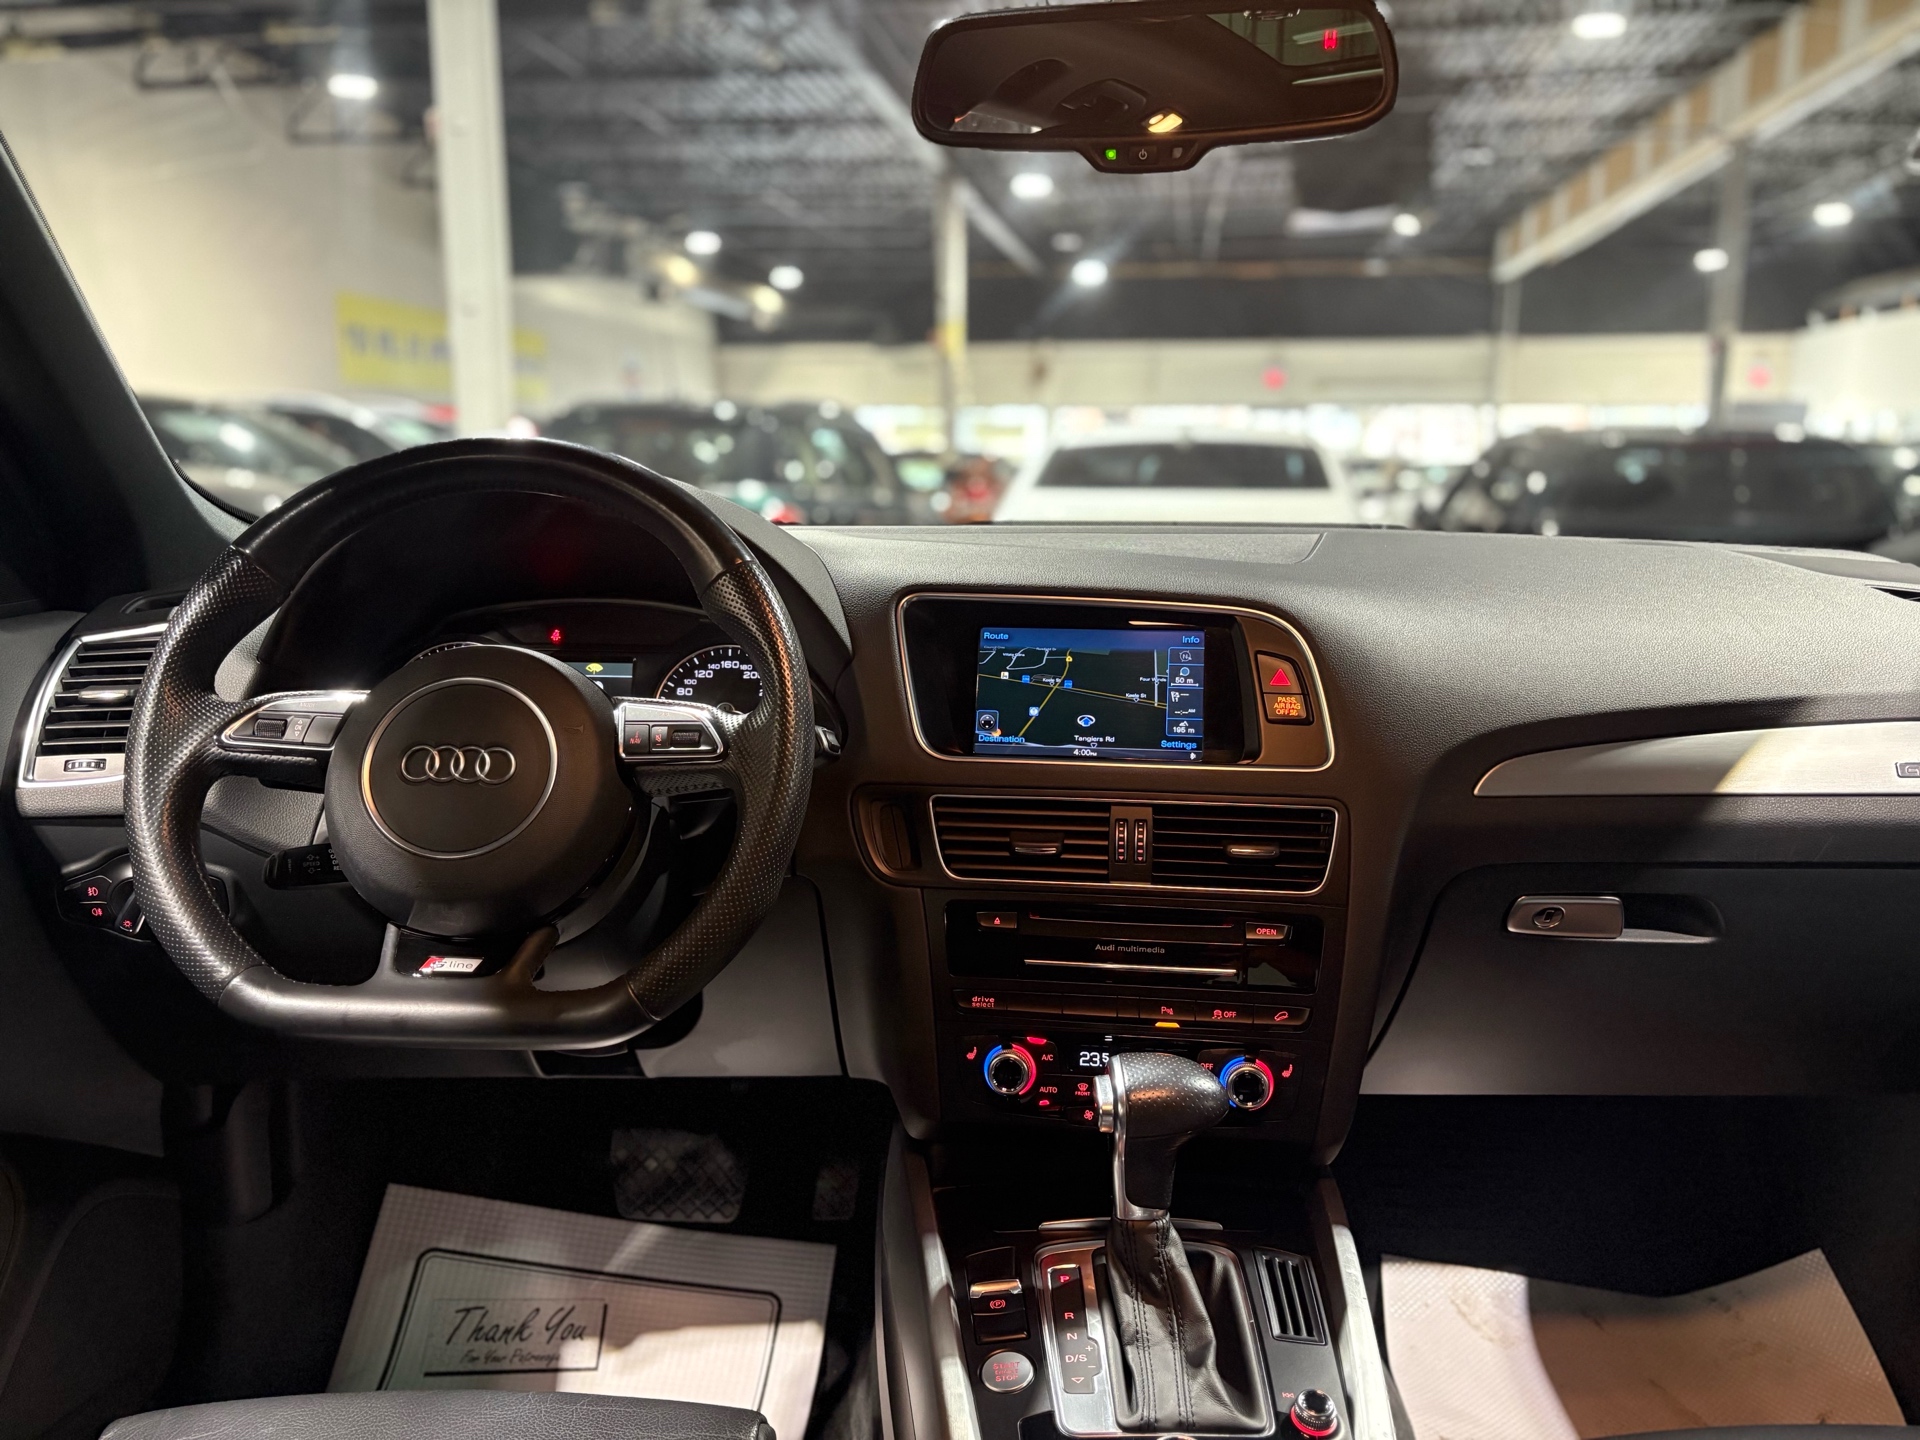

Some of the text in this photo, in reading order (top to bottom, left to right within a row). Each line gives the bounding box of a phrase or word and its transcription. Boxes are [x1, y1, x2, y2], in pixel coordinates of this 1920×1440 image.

[983, 631, 1009, 640] Route
[1182, 635, 1200, 644] Info
[720, 660, 740, 669] 160
[694, 670, 713, 678] 120
[742, 671, 761, 679] 20
[676, 687, 693, 696] 80
[978, 735, 1025, 743] Destination
[1073, 735, 1103, 743] Tangiers
[1160, 740, 1198, 750] Settings
[1256, 927, 1277, 936] OPEN
[1095, 943, 1165, 954] Audi multimedia
[449, 960, 474, 969] line
[972, 995, 995, 1003] drive
[1079, 1051, 1110, 1067] 23.5
[446, 1305, 588, 1345] Thank You
[1065, 1354, 1087, 1363] D/S
[993, 1361, 1020, 1370] START
